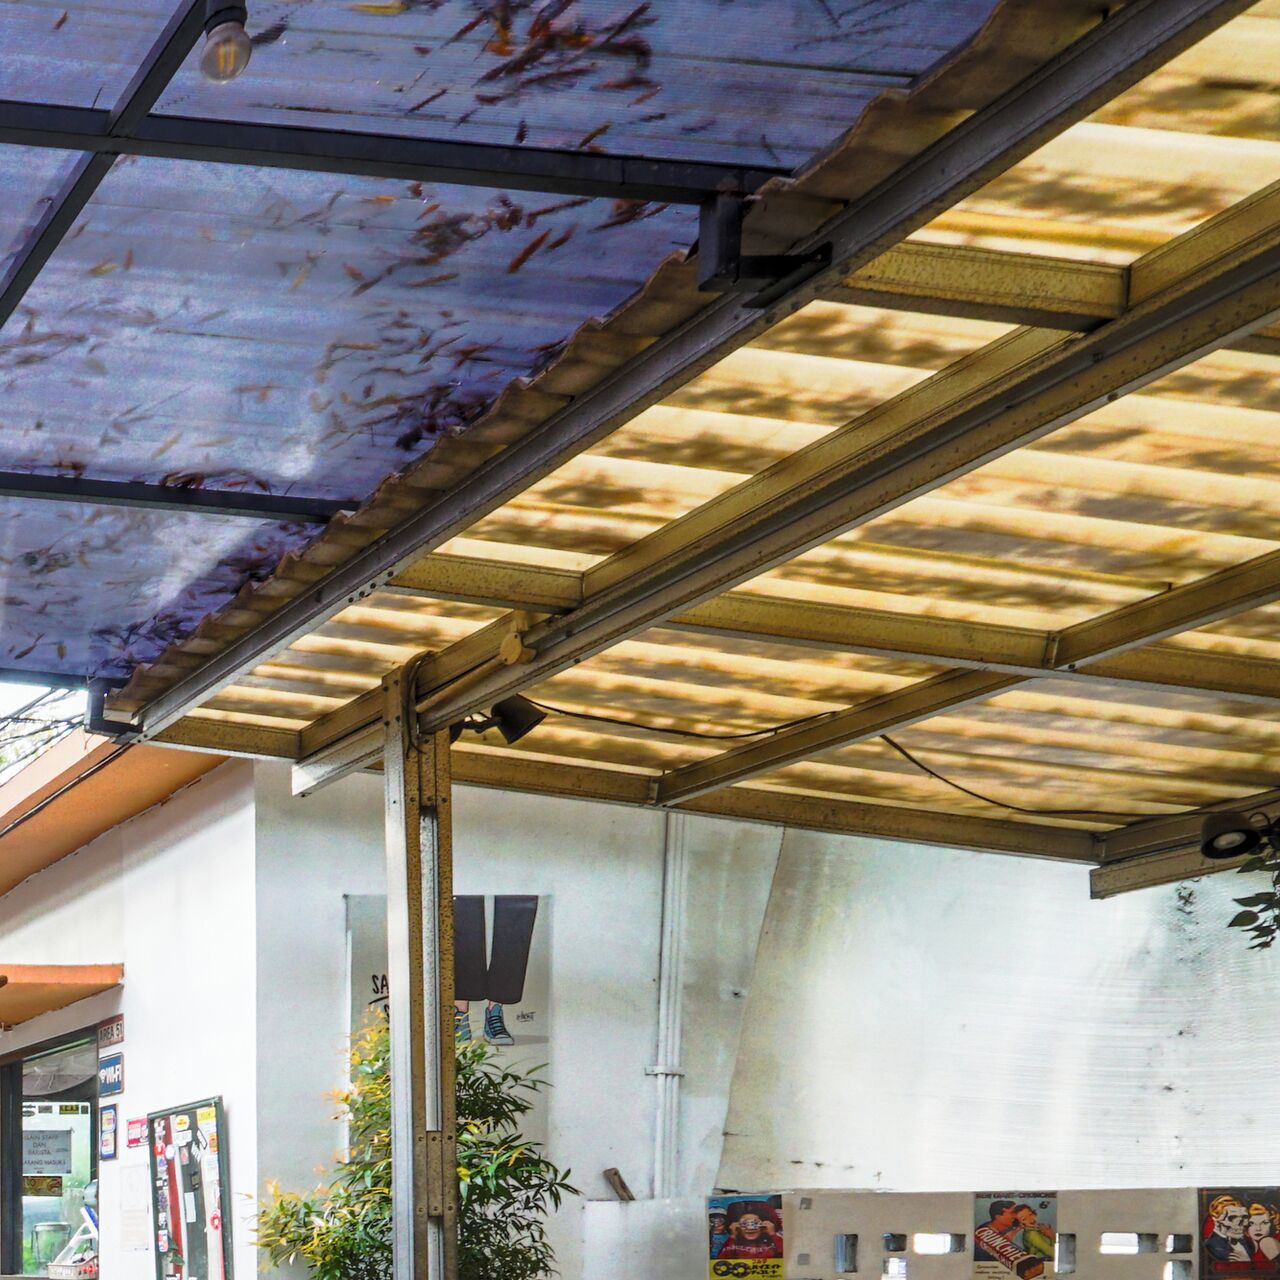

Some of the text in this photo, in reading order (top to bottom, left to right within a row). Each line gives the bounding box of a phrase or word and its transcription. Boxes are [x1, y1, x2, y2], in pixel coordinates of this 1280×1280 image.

[99, 1022, 124, 1041] AREA 51
[974, 1226, 1029, 1263] CRUNCHIE
